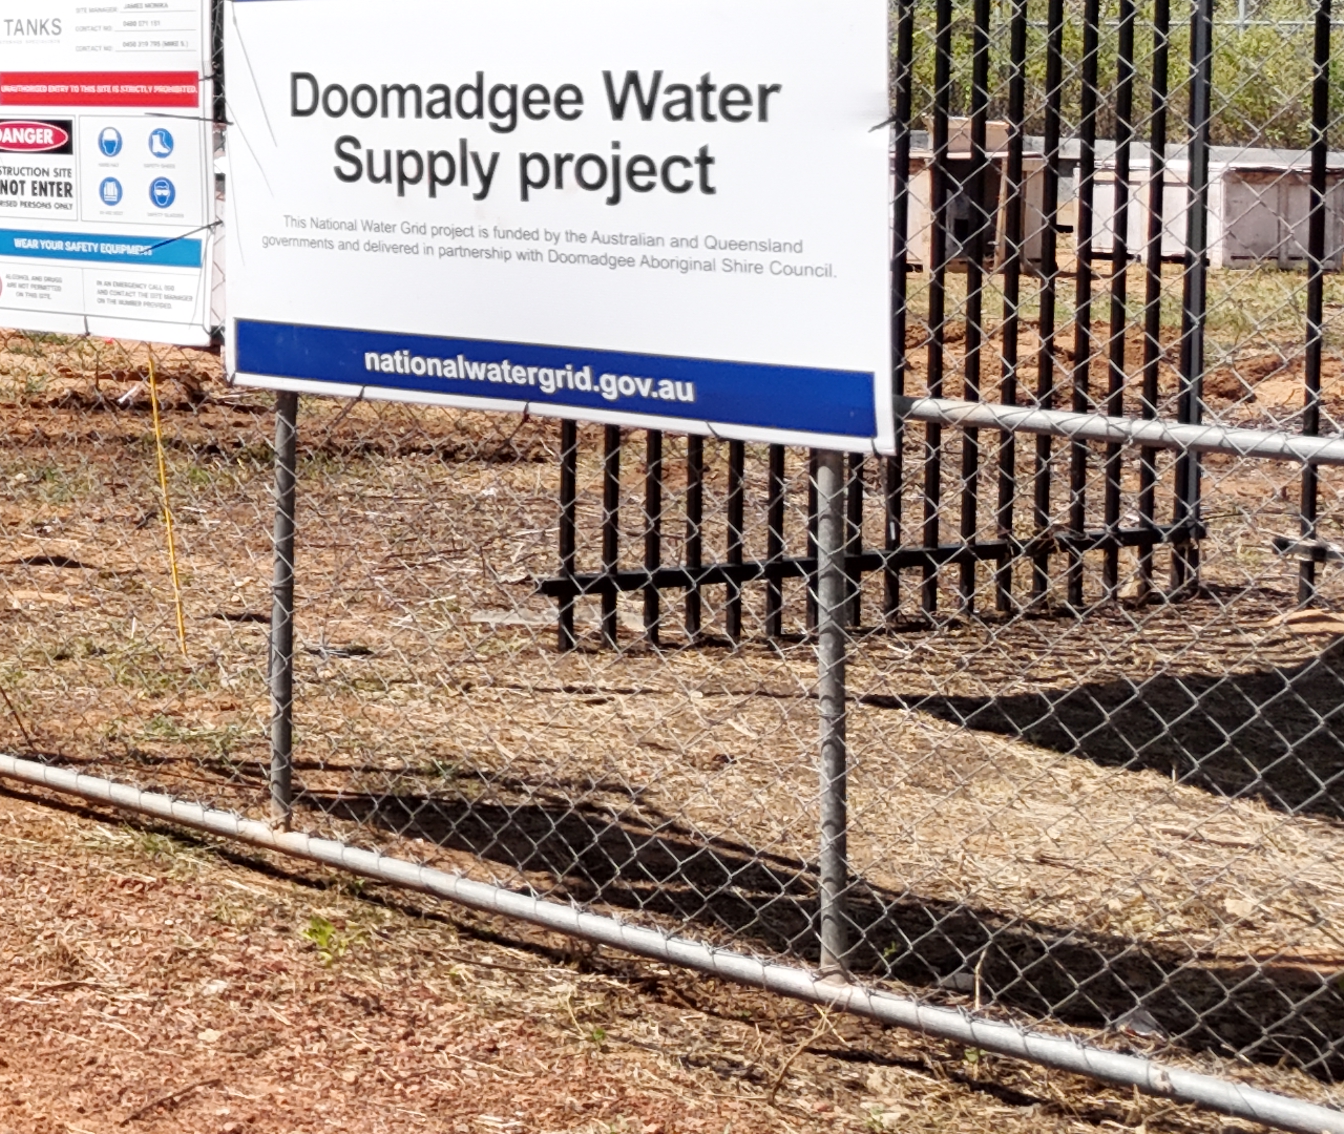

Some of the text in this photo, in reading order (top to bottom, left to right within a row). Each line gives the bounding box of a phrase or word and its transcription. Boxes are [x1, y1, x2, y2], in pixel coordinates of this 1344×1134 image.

[3, 17, 62, 36] TANKS
[120, 84, 152, 93] STRICTLY
[290, 69, 782, 134] Doomadgee Water
[53, 167, 72, 178] SITE
[333, 134, 717, 206] Supply project
[0, 179, 26, 196] NOT
[31, 180, 73, 198] ENTER
[19, 200, 52, 209] PERSONS
[53, 201, 73, 210] ONLY
[283, 215, 803, 253] This National Water Grid project is funded by the Australian and Queensland
[14, 238, 39, 249] WEAR
[39, 240, 64, 251] YOUR
[64, 241, 98, 253] SAFETY
[261, 234, 837, 279] governments and delivered in partnership with Doomadgee Aboriginal Shire Council.
[109, 289, 136, 297] CONTACT
[112, 281, 147, 289] EMERGENCY
[148, 283, 163, 291] CALL
[364, 350, 696, 403] nationalwatergrid.gov.au
